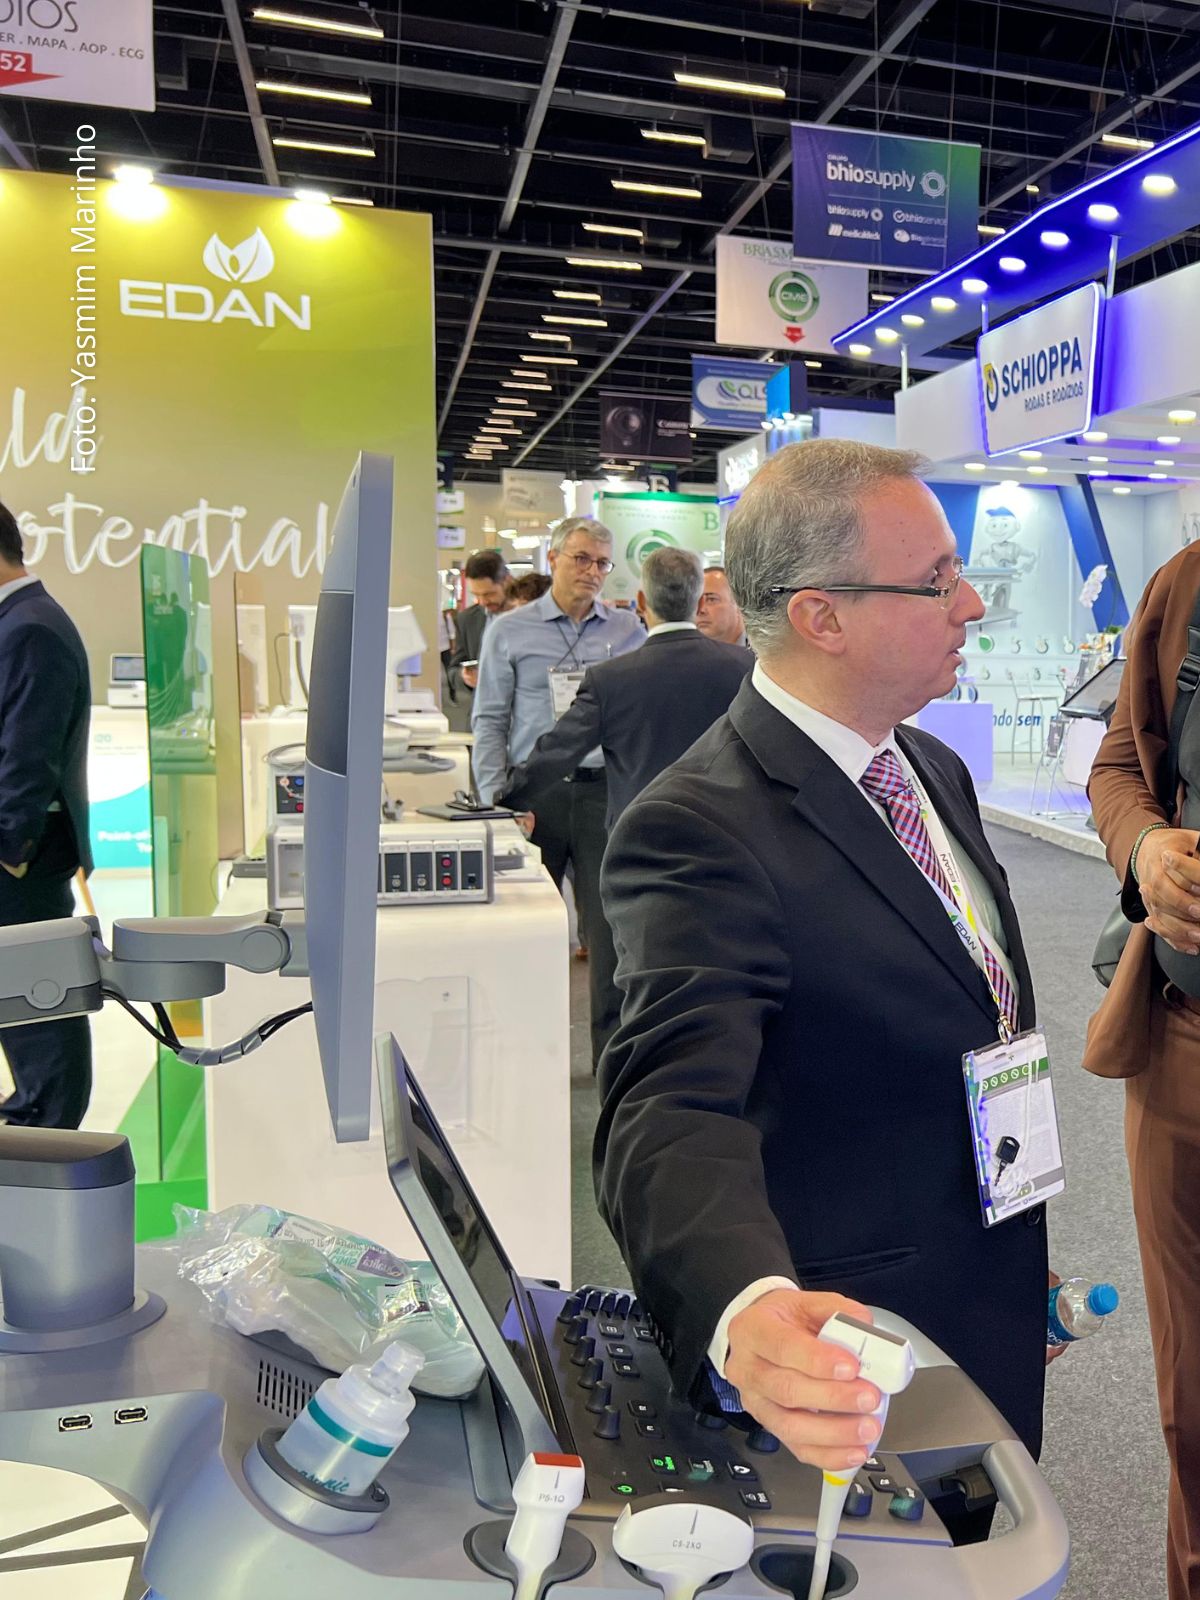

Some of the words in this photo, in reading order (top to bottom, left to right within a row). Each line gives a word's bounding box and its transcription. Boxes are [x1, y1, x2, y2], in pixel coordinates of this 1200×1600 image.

[0, 53, 27, 73] 52
[27, 35, 68, 50] MAPA
[79, 42, 108, 55] AOP
[119, 47, 145, 60] ECG
[826, 161, 916, 193] bhiosupply
[119, 278, 311, 331] EDAN
[1002, 336, 1083, 398] SCHIOPPA
[955, 921, 977, 951] EDAN
